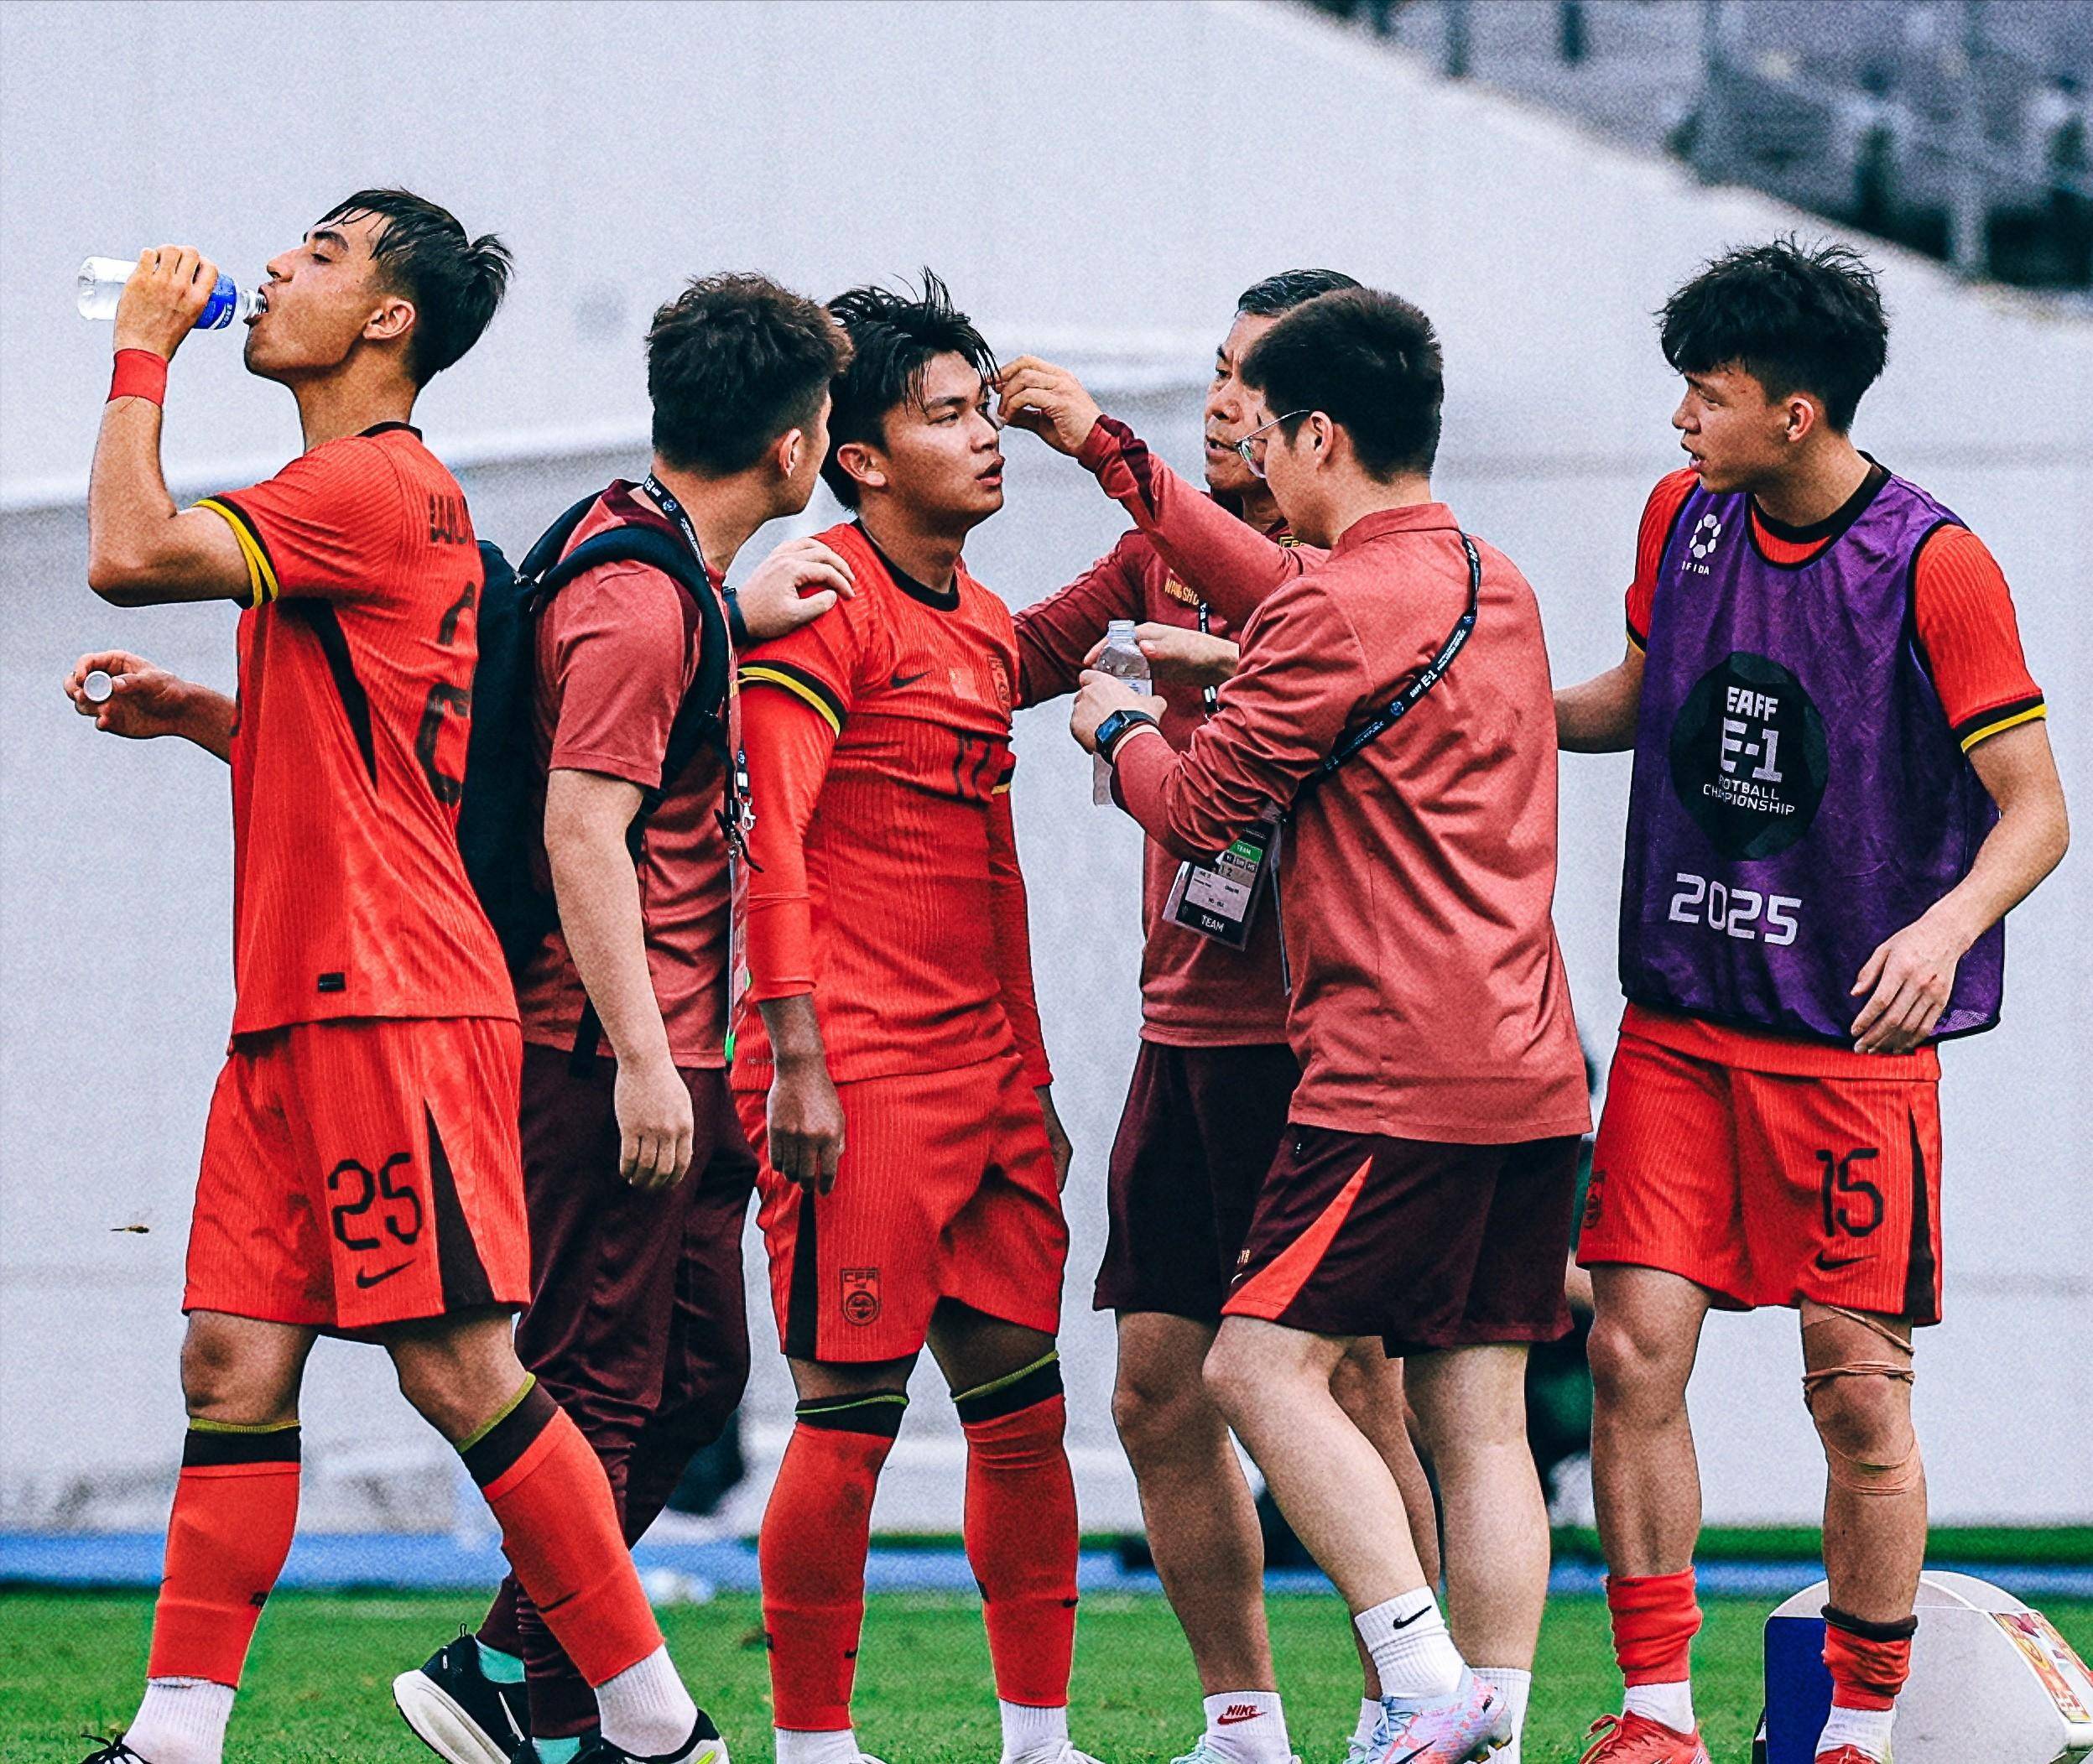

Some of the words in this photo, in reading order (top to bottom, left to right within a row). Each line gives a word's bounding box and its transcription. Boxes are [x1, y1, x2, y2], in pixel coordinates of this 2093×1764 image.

[1420, 669, 1438, 688] E-1
[1726, 686, 1778, 721] EAFF
[1721, 717, 1783, 783] E-1
[1237, 844, 1252, 855] TEAM
[1201, 914, 1225, 933] TEAM
[1669, 872, 1802, 945] 2025
[328, 1153, 423, 1251] 25
[1815, 1147, 1884, 1237] 15
[1226, 1704, 1257, 1716] NIKE
